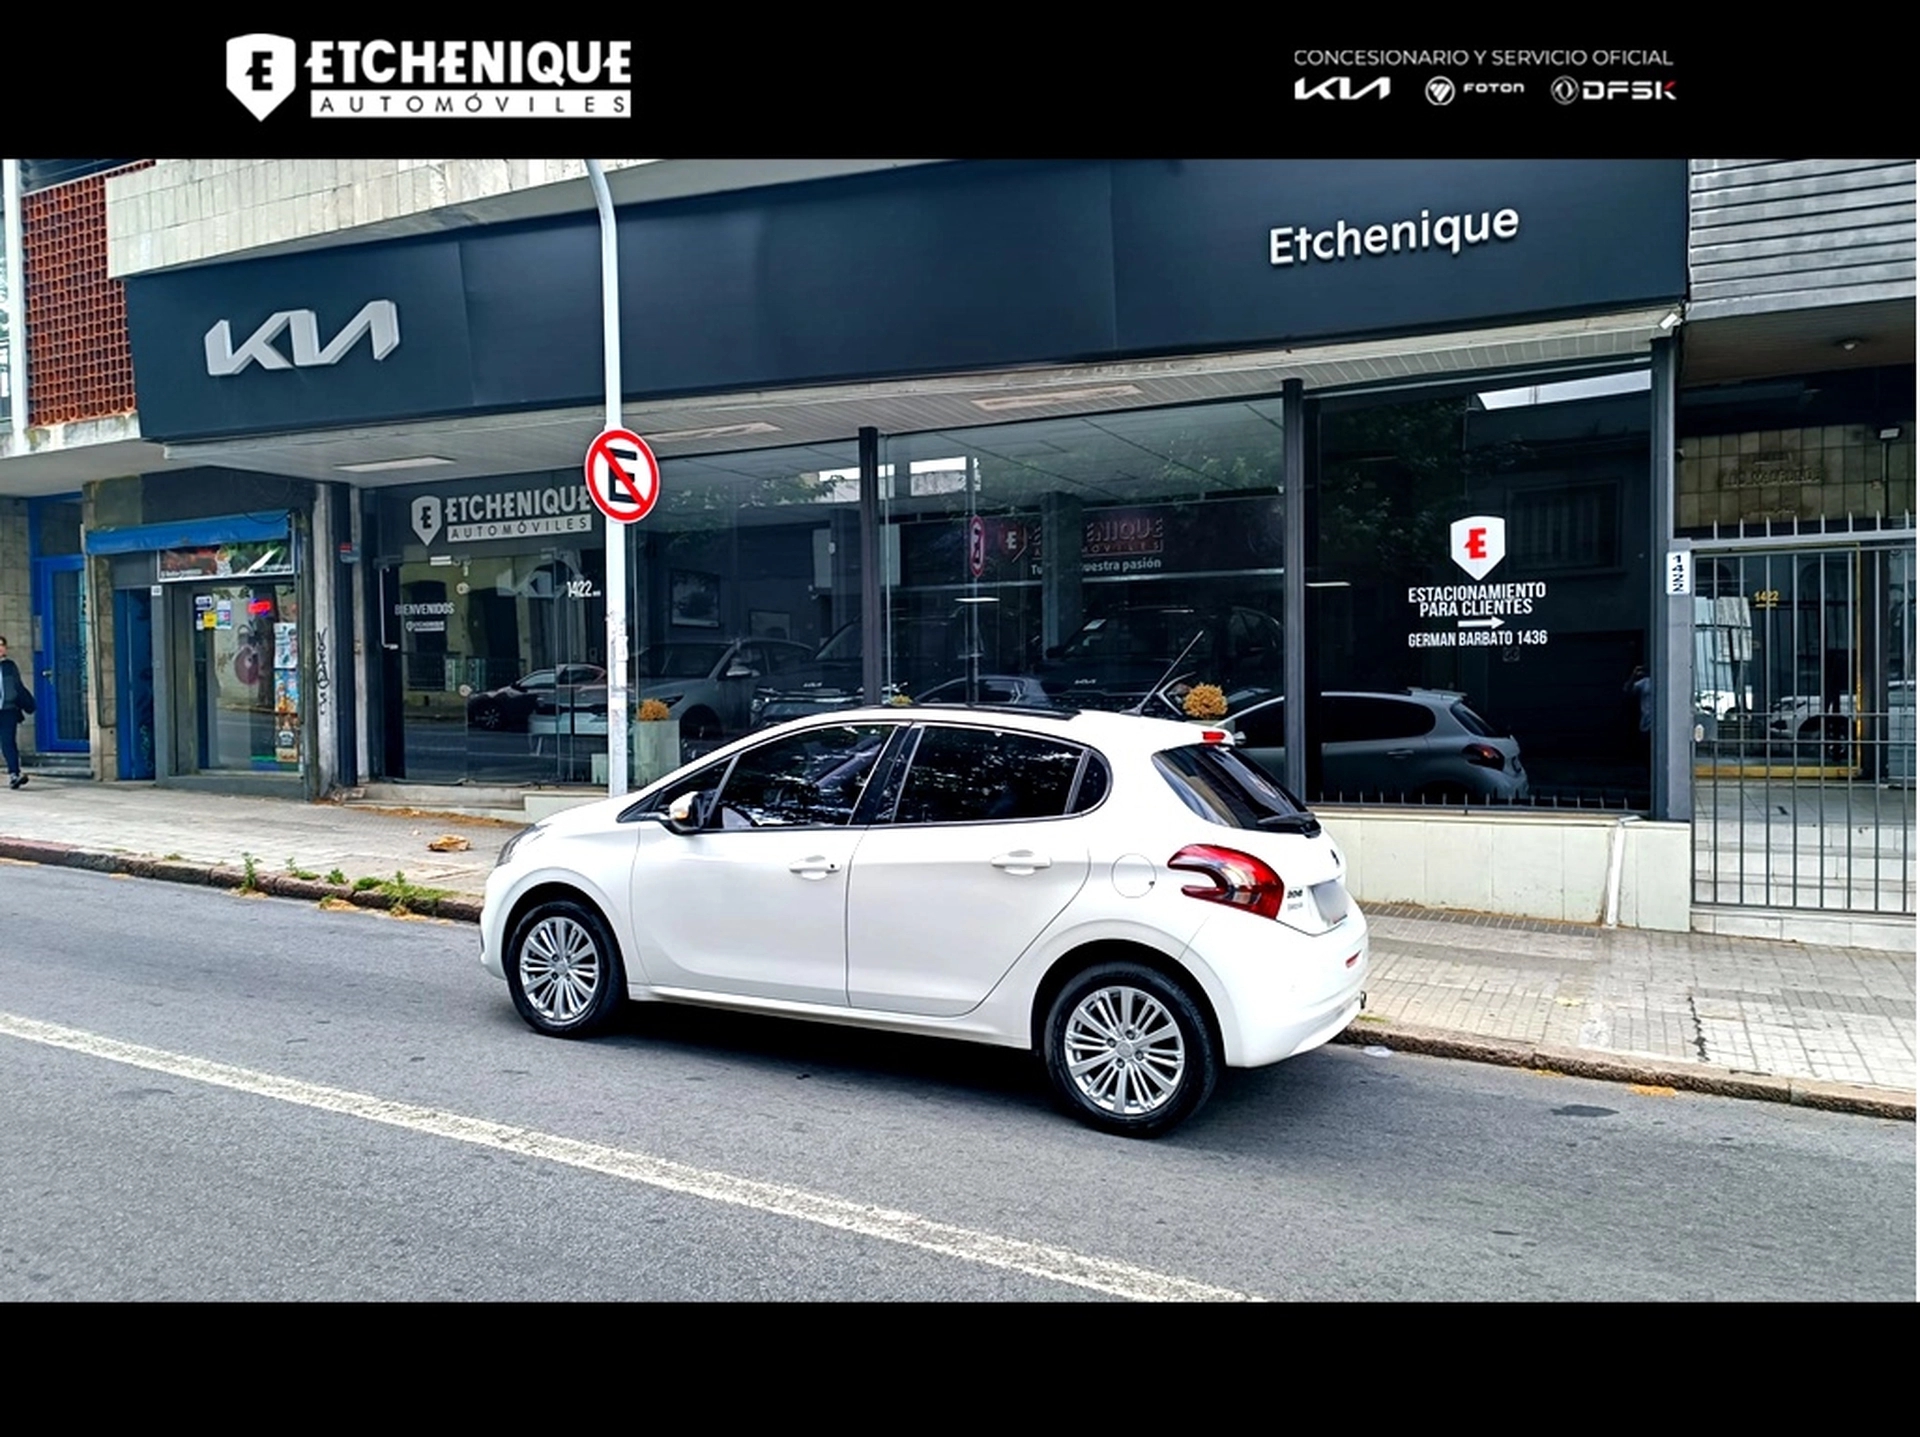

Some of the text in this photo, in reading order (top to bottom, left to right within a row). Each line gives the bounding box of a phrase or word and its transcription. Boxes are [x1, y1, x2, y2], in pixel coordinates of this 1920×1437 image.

[1270, 207, 1519, 265] Etchenique
[205, 300, 400, 377] KIA
[608, 447, 638, 504] E
[445, 485, 591, 523] ETCHENIQUE
[451, 517, 587, 539] AUTOMÓVILES
[1083, 560, 1120, 572] uestra
[1671, 554, 1684, 593] 1422
[567, 580, 593, 598] 1422
[1408, 582, 1546, 603] ESTACIONAMIENTO
[395, 602, 455, 615] BIENVENIDOS
[1420, 598, 1533, 617] PARA CLIENTES
[1408, 629, 1548, 647] GERMAN BARBATO 1436
